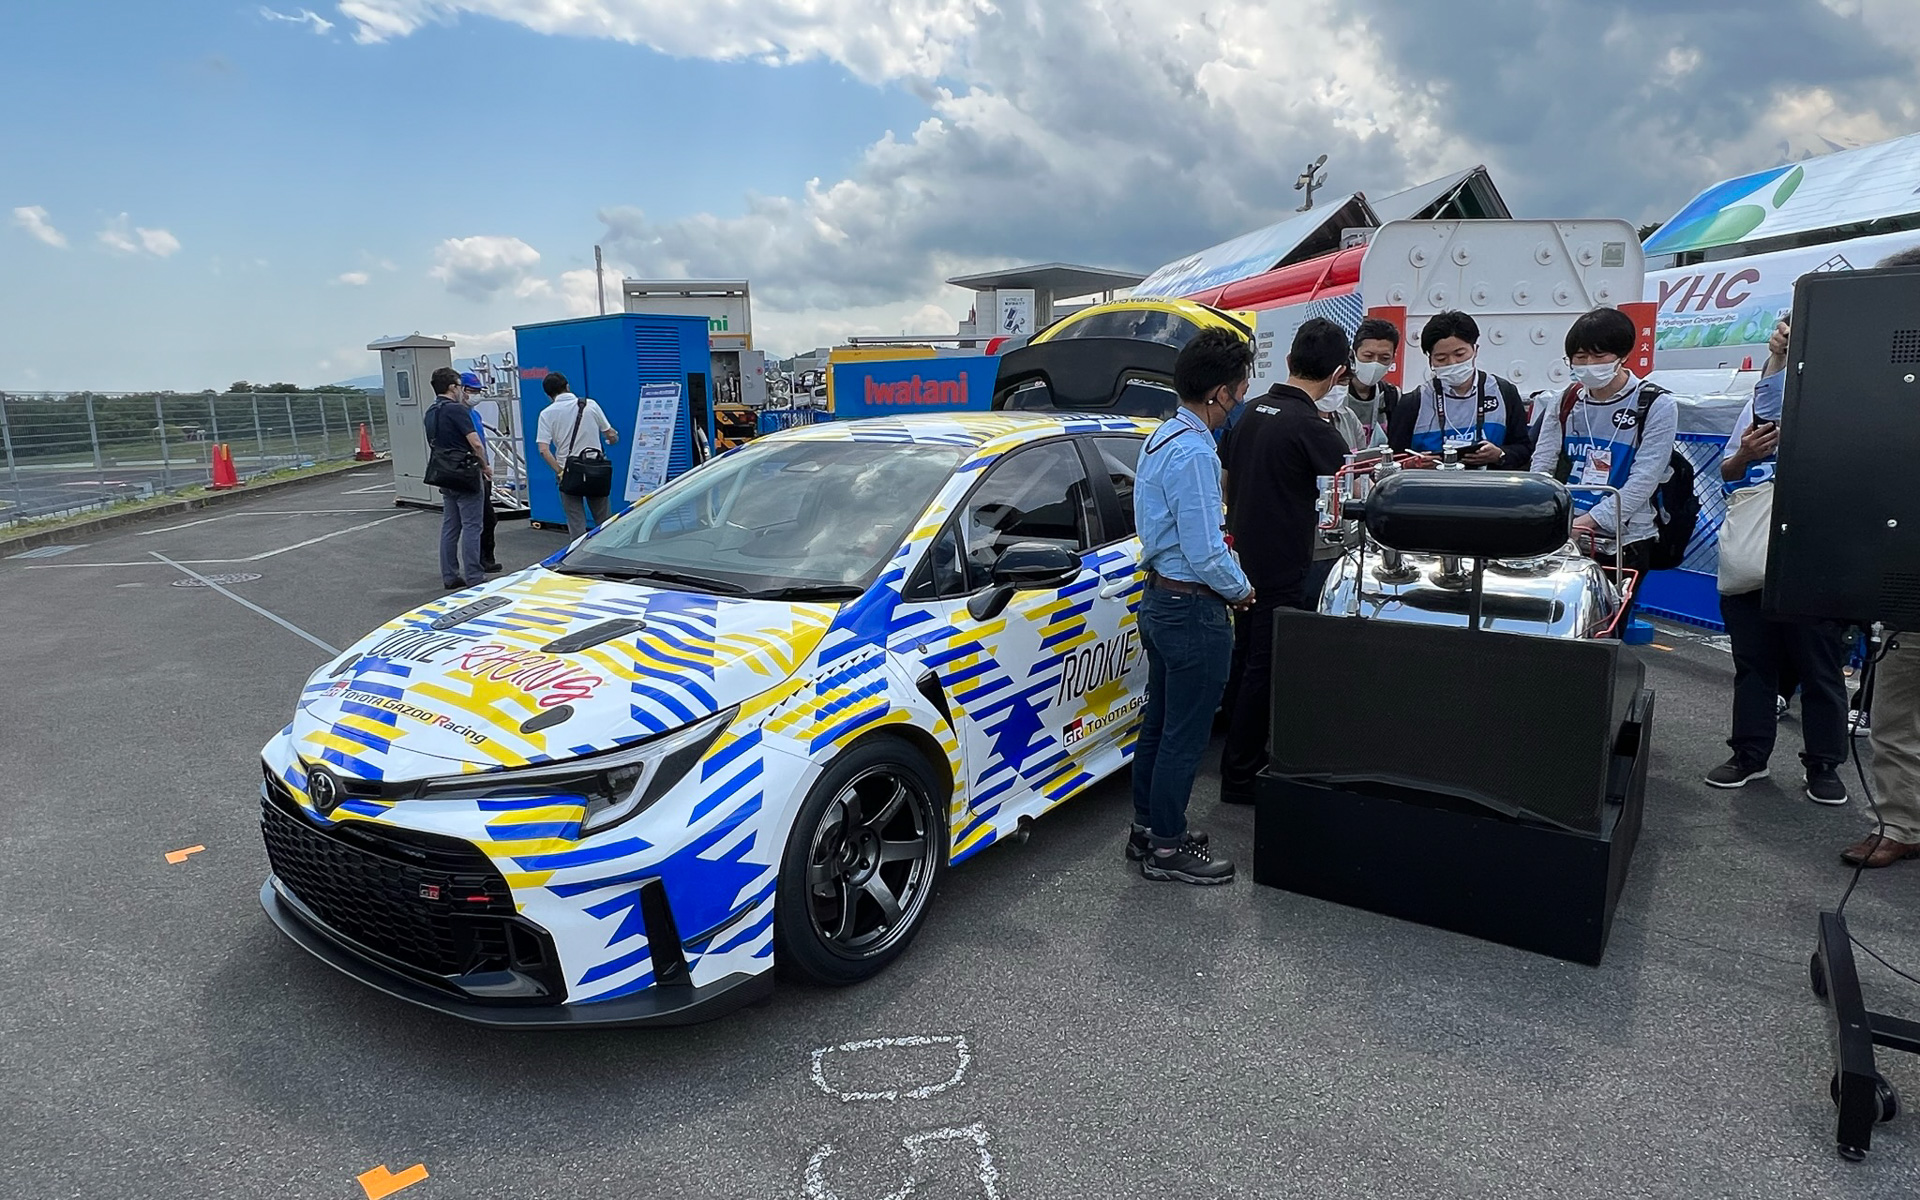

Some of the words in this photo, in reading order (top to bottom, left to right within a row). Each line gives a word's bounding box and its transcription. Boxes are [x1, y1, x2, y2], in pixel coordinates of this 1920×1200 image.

[1658, 268, 1761, 313] YHC
[864, 371, 969, 405] Iwatani
[1613, 413, 1636, 426] 556
[366, 628, 481, 663] OOKIE
[441, 645, 603, 707] RACING
[1057, 627, 1137, 707] ROOKIE
[339, 688, 383, 706] TOYOTA
[382, 699, 434, 722] GAZOO
[431, 715, 488, 745] Racing
[1063, 725, 1084, 747] GR
[1086, 704, 1127, 733] TOYOTA
[1130, 691, 1150, 710] GAZ
[420, 887, 439, 899] GR
